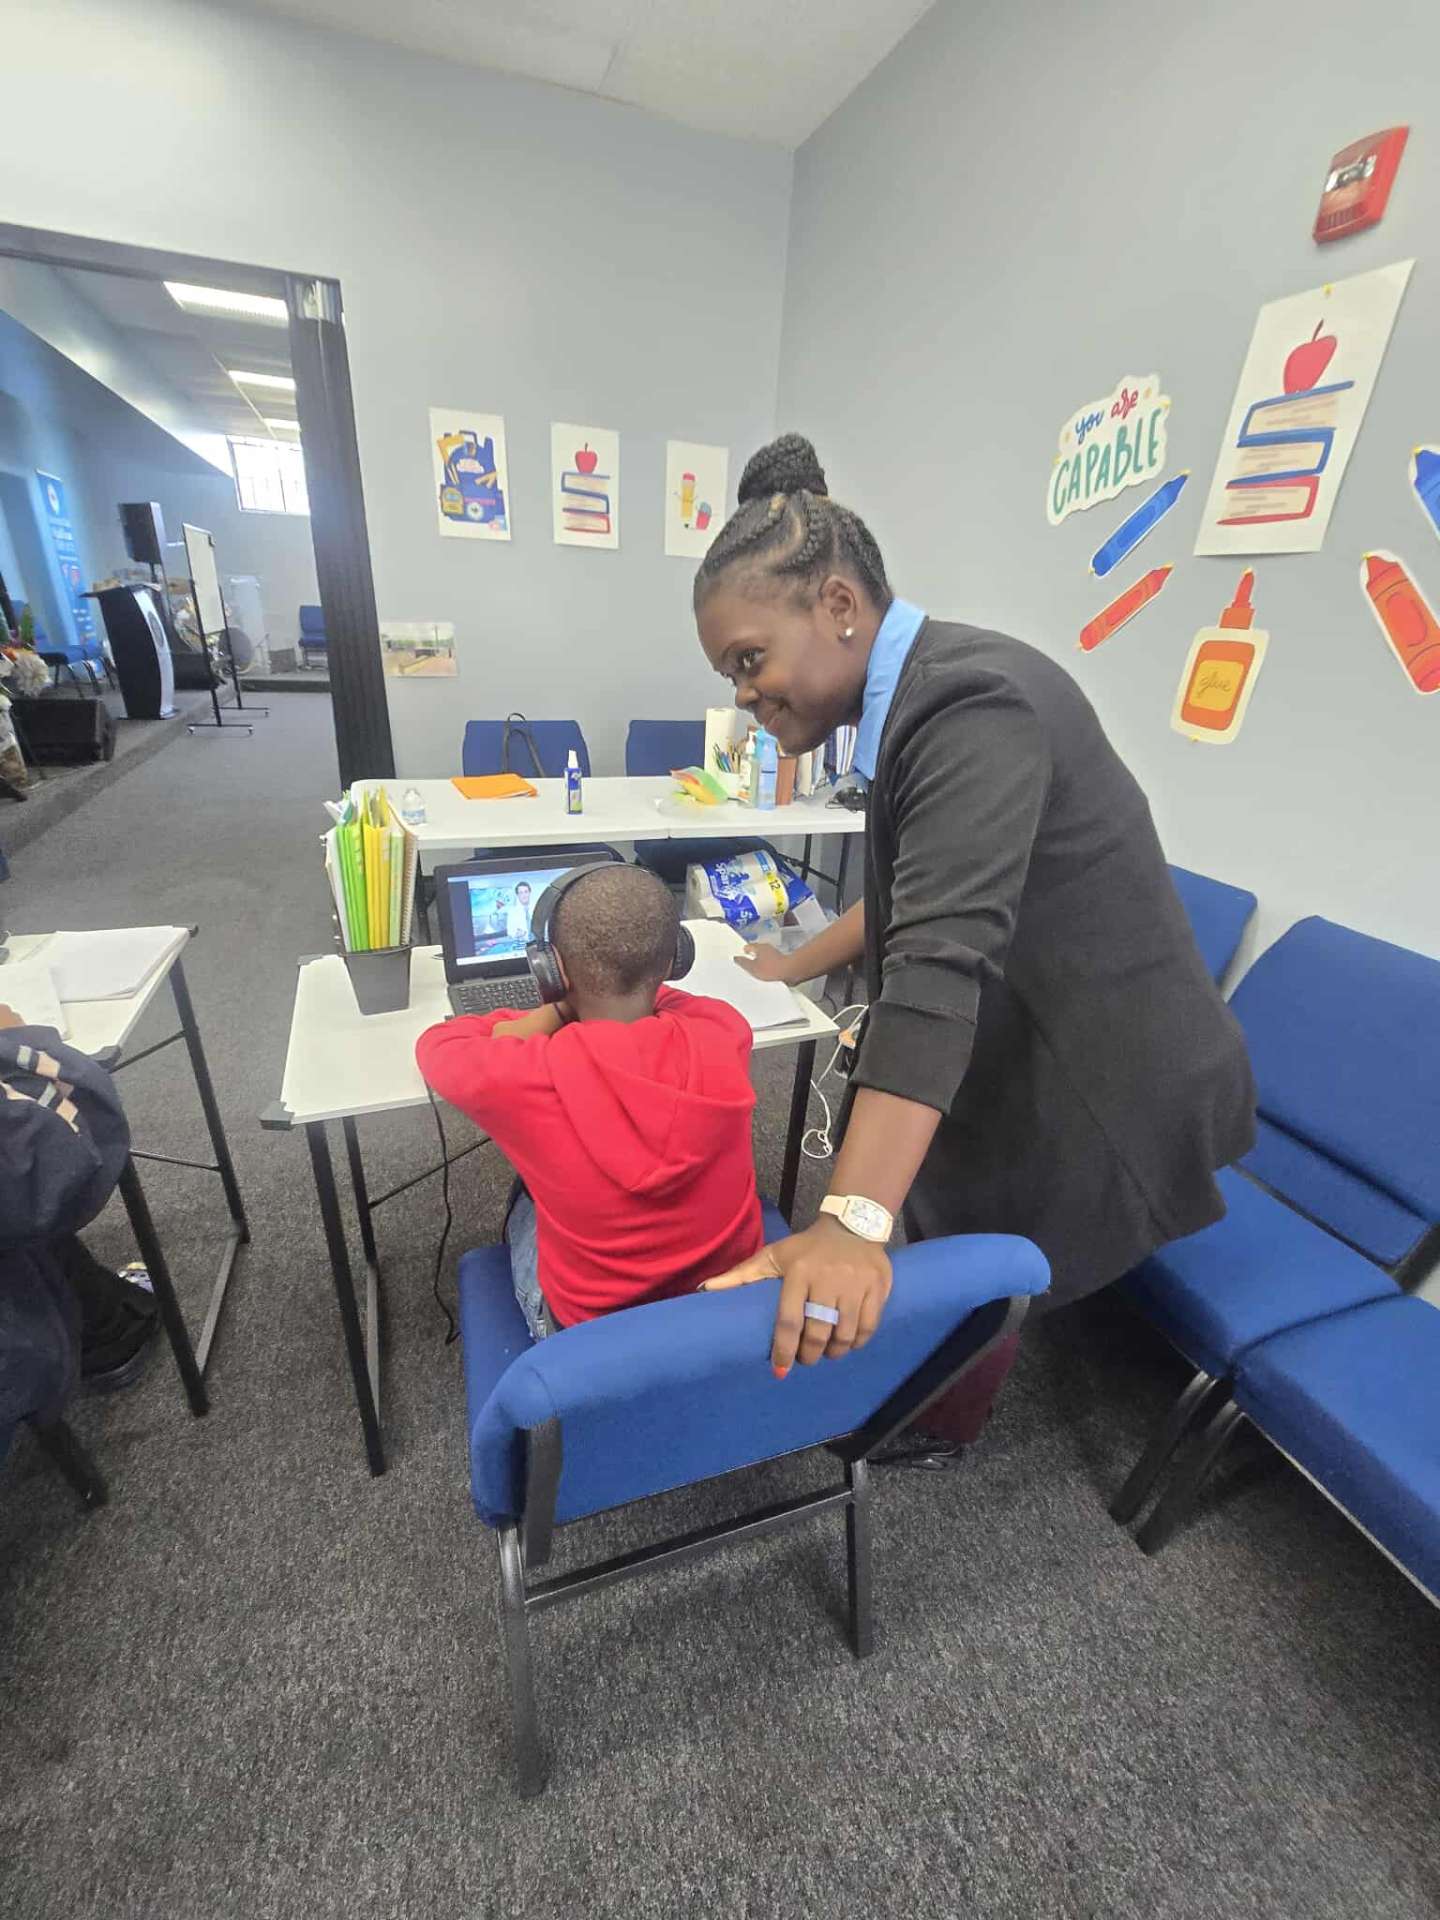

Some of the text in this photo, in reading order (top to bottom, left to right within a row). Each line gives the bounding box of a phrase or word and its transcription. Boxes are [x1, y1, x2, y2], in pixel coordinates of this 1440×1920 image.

[1075, 387, 1139, 445] you are
[1053, 408, 1161, 516] CAPABLE
[1196, 671, 1232, 699] glue
[768, 879, 781, 891] 12
